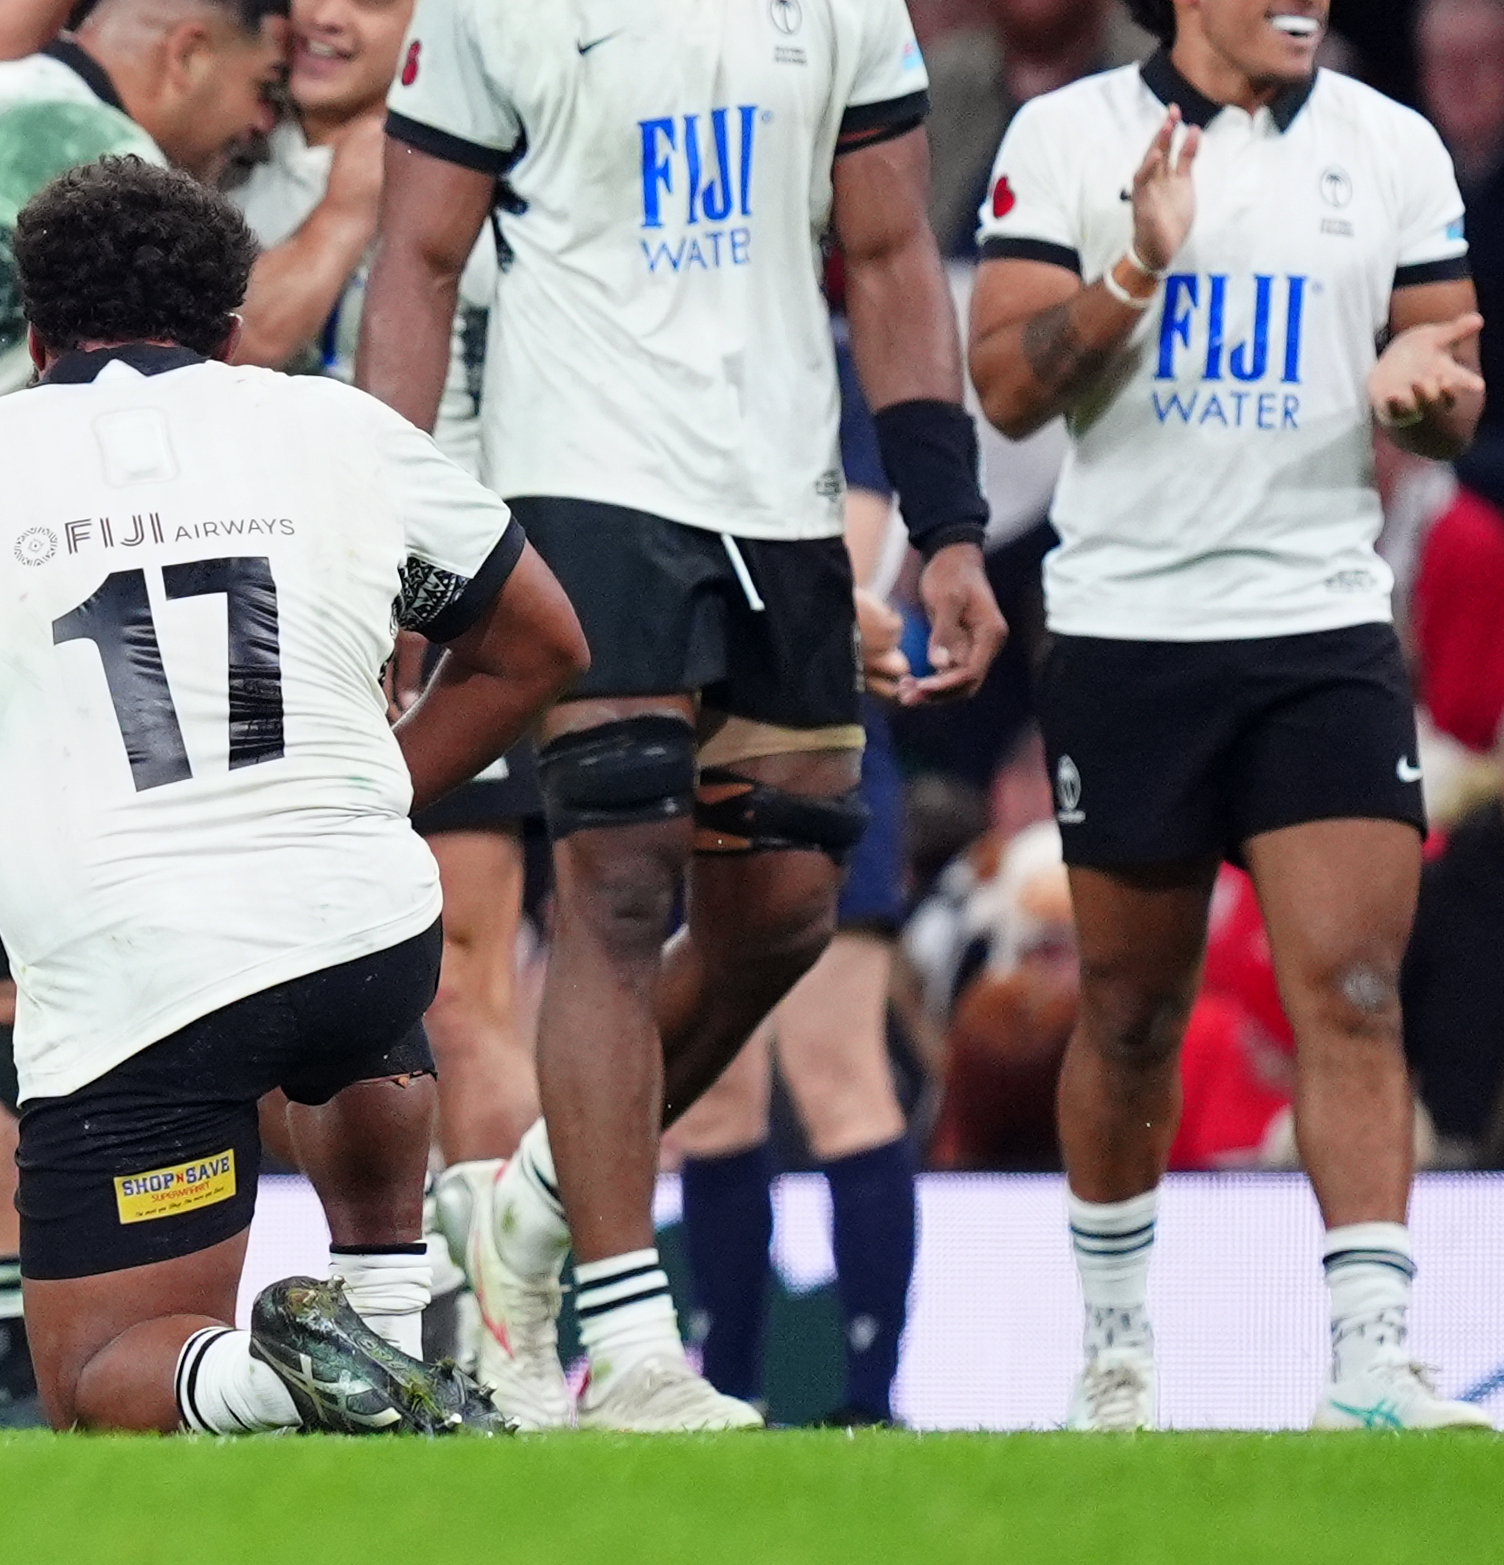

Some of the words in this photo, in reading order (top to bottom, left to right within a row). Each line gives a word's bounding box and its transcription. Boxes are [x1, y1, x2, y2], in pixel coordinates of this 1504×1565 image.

[637, 106, 758, 228] FIJI
[1154, 273, 1307, 384] FIJI
[1151, 390, 1301, 430] WATER
[64, 512, 165, 555] FIJI
[175, 518, 296, 543] AIRWAYS
[53, 556, 286, 792] 17
[121, 1172, 174, 1197] SHOP
[176, 1173, 184, 1184] N
[185, 1156, 231, 1185] SAVE
